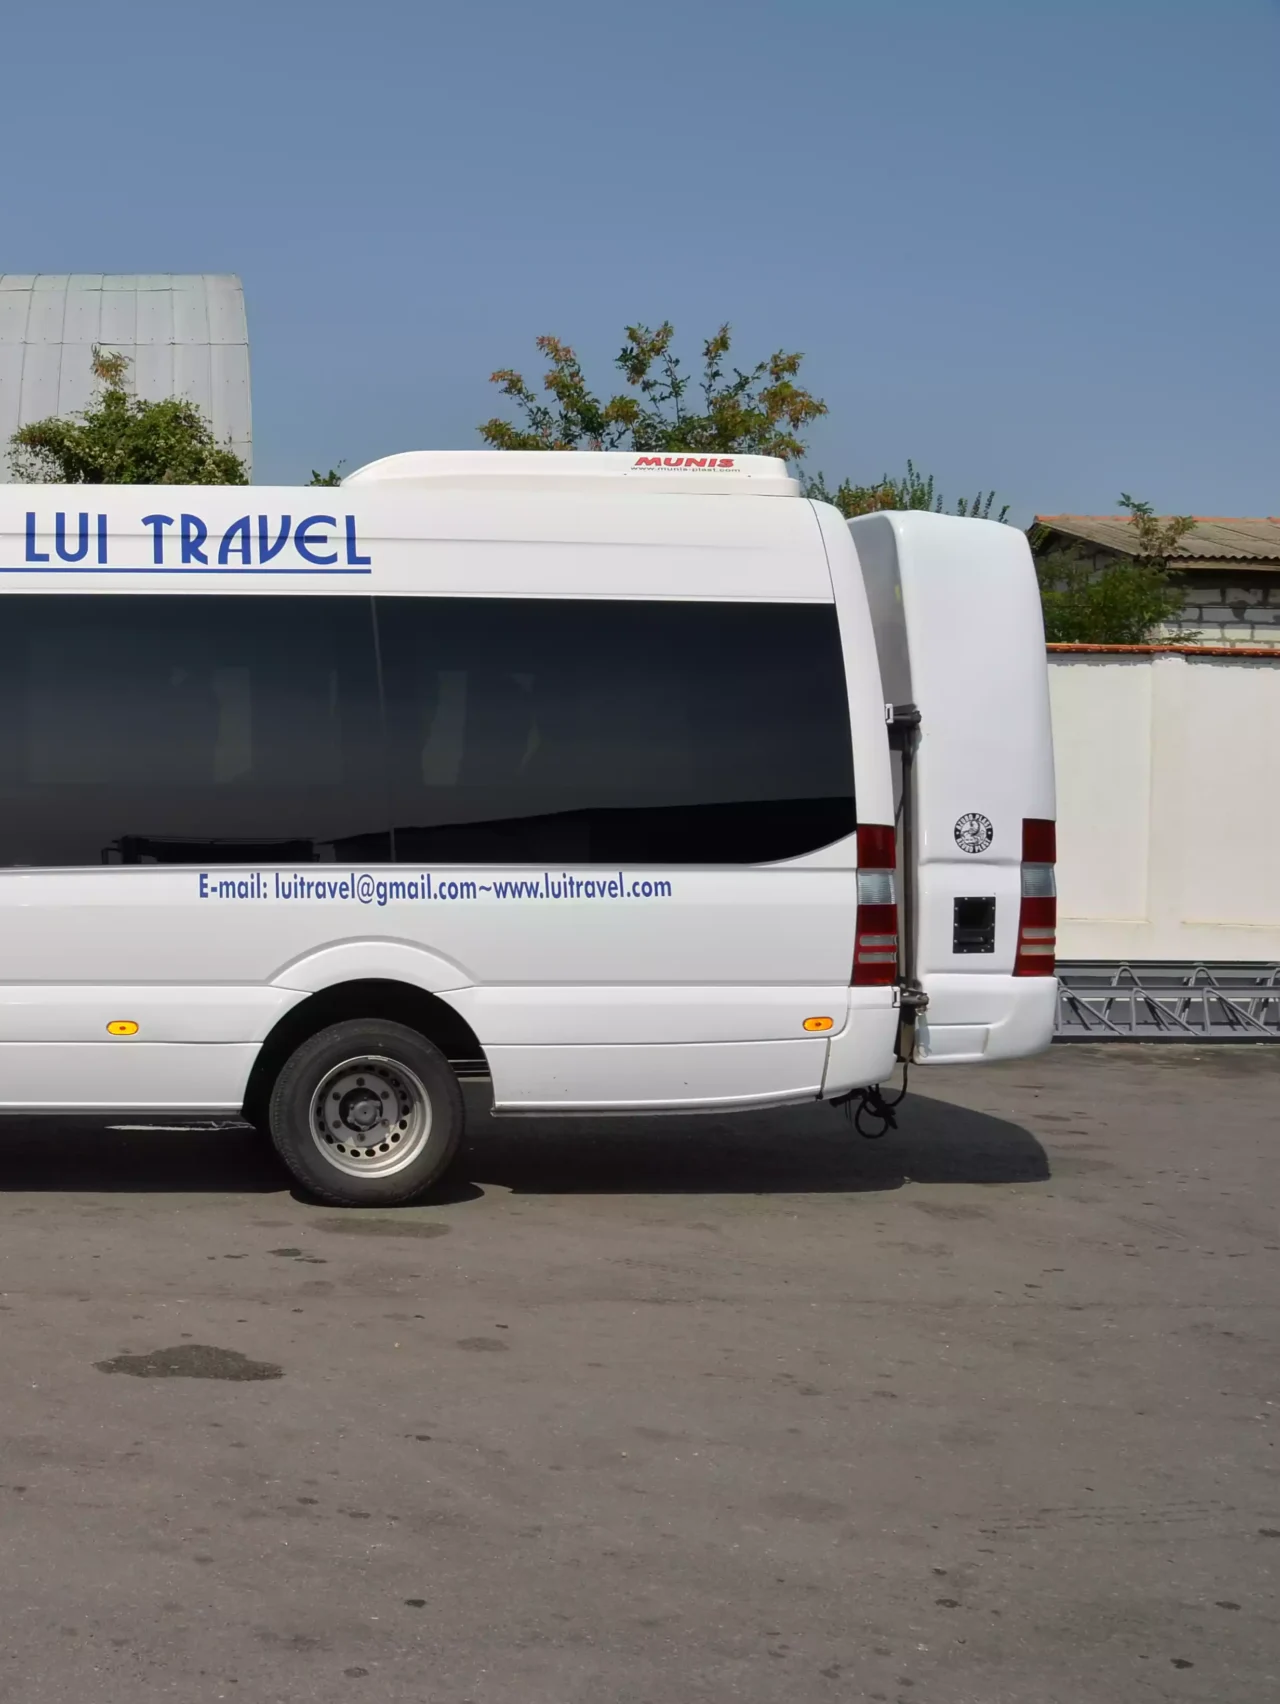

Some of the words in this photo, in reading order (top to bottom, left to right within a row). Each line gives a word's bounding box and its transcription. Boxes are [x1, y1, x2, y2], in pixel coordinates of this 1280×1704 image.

[634, 456, 735, 468] MUNIS
[25, 511, 108, 565] LUI
[141, 513, 372, 566] TRAVEL
[199, 873, 268, 899] E-mail:
